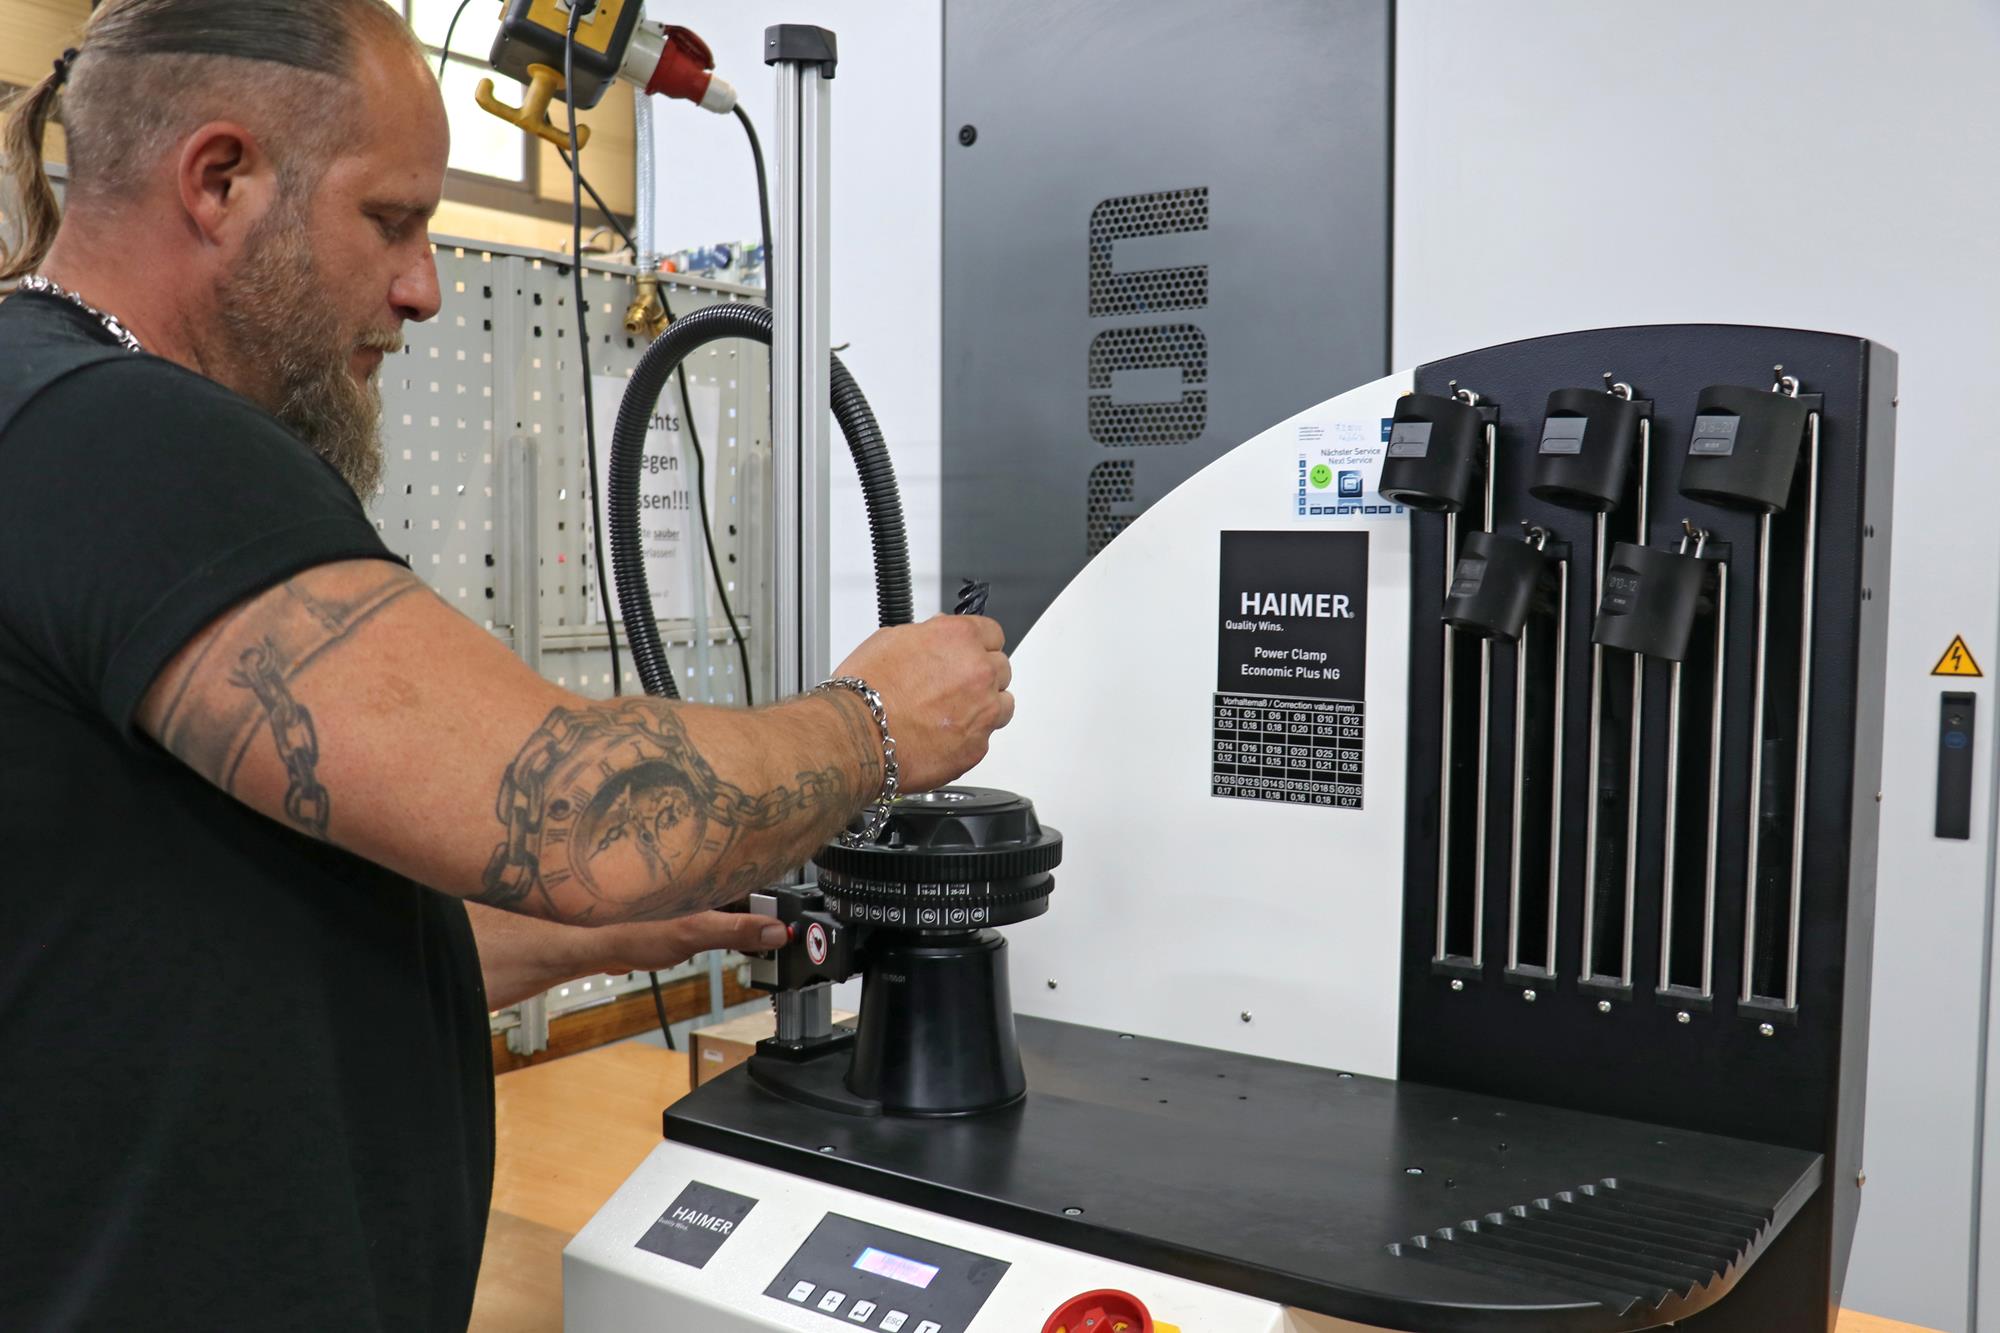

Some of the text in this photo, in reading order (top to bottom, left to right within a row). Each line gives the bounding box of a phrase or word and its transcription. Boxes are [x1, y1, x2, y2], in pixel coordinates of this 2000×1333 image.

[1321, 447, 1381, 457] Nächster Service
[1328, 457, 1345, 465] Next
[1225, 620, 1285, 632] Quality Wins.
[1254, 647, 1327, 663] Power Clamp
[1241, 664, 1340, 680] Economic Plus NG
[1273, 699, 1312, 709] Correction
[1314, 702, 1334, 711] value
[1335, 704, 1355, 713] (mm)
[1218, 720, 1358, 737] 0,15 0,18 0,18 0,20 0,15 0,14
[1217, 753, 1358, 772] 0,12 0,14 0,15 0,13 0,21 0,16
[884, 1315, 903, 1327] ESC
